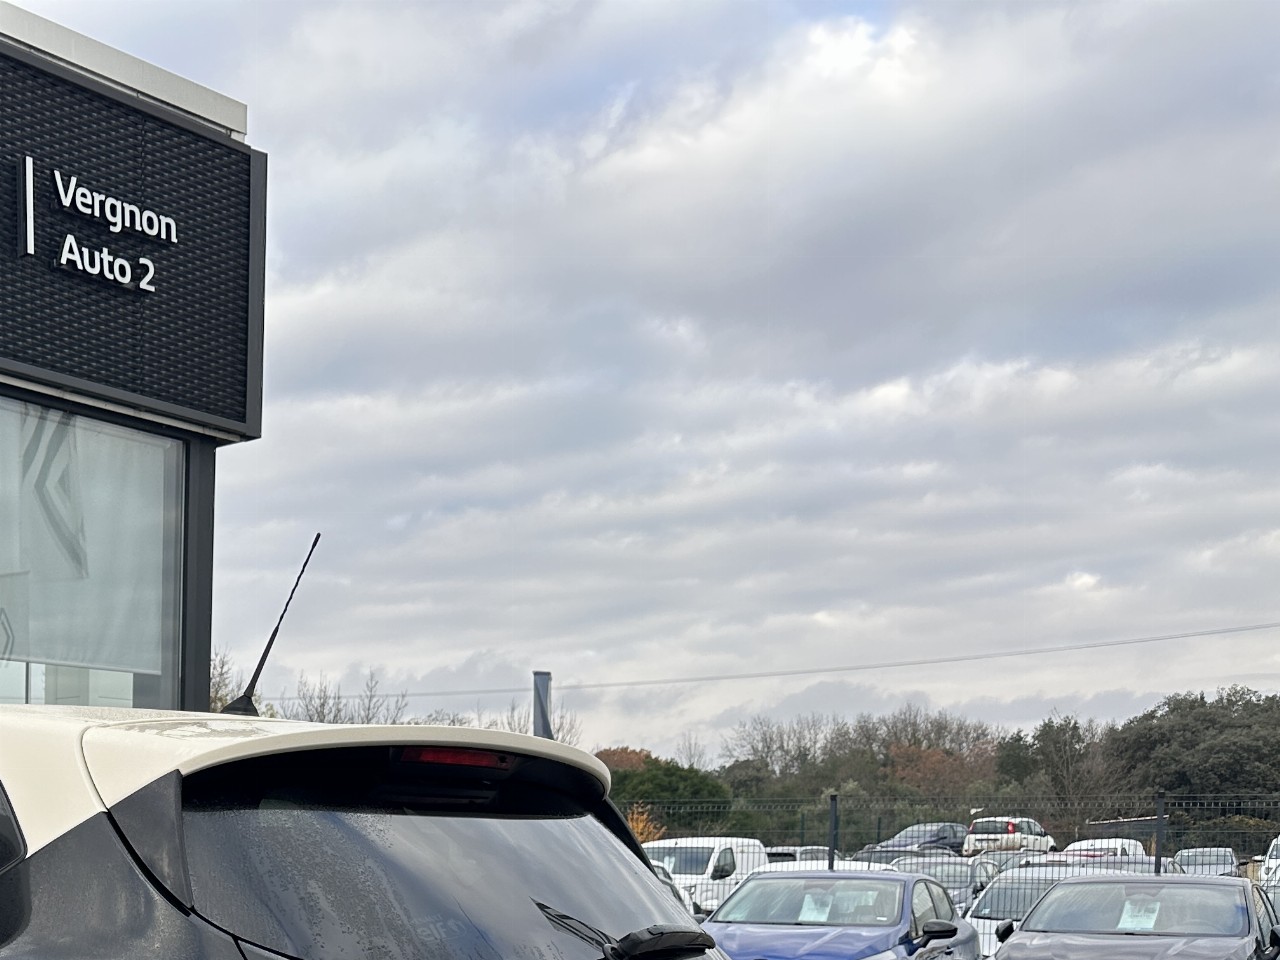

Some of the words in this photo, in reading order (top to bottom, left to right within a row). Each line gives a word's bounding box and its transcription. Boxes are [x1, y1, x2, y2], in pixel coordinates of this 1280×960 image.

[54, 170, 178, 243] Vergnon
[60, 234, 132, 285] Auto
[138, 258, 156, 292] 2
